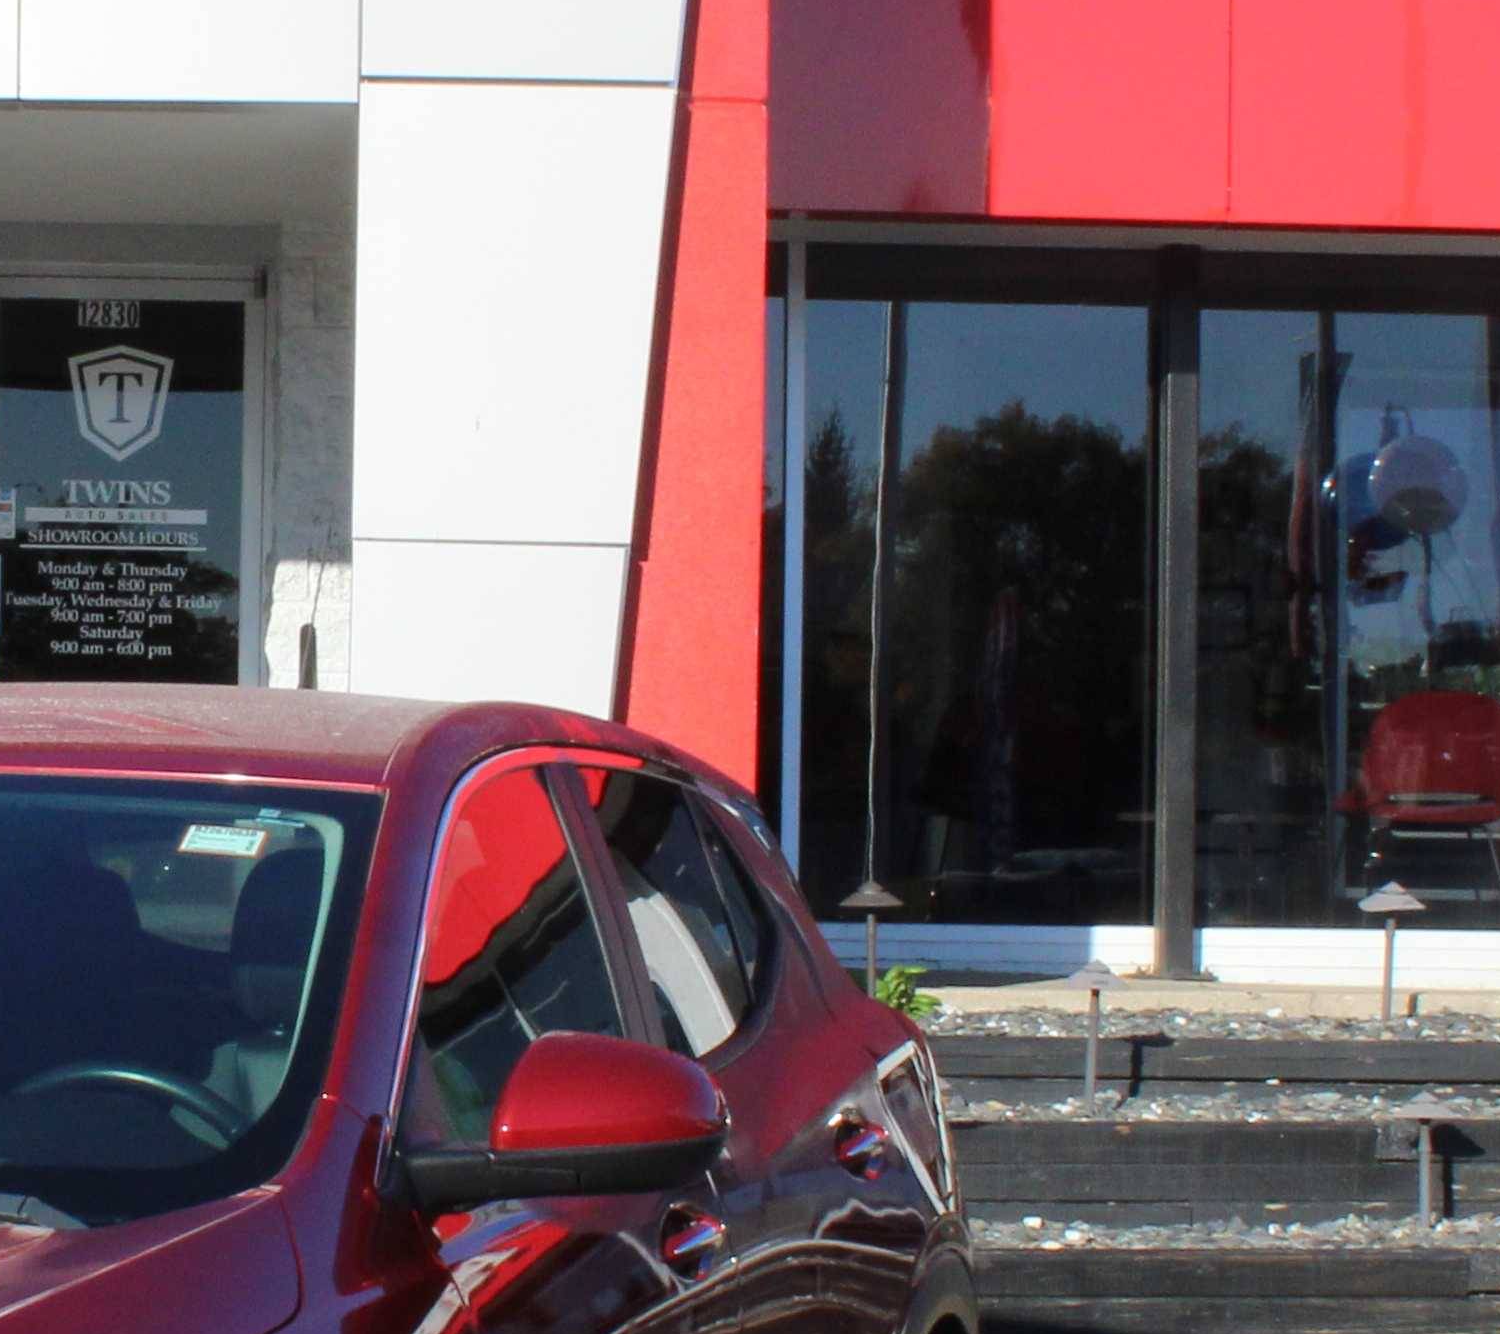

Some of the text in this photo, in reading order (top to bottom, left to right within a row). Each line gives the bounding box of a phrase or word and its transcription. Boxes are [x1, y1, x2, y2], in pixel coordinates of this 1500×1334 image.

[80, 301, 139, 328] 12830
[98, 372, 144, 424] T
[62, 479, 172, 506] TWINS
[64, 509, 106, 521] AUTO
[27, 528, 200, 546] SHOWROOM HOURS
[37, 561, 188, 581] Monday & Thursday
[51, 578, 80, 592] 9:00
[82, 581, 105, 592] am
[117, 579, 145, 593] 8:00
[148, 583, 173, 597] pm
[4, 592, 223, 612] Tuesday, Wednesday & Friday
[50, 609, 79, 623] 9:00
[81, 612, 105, 623] am
[117, 610, 145, 624] 7:00
[148, 613, 173, 627] pm
[79, 625, 144, 643] Saturday
[50, 641, 79, 655] 9:00
[81, 644, 104, 655] am
[116, 642, 145, 656] 6:00
[148, 645, 172, 659] pm
